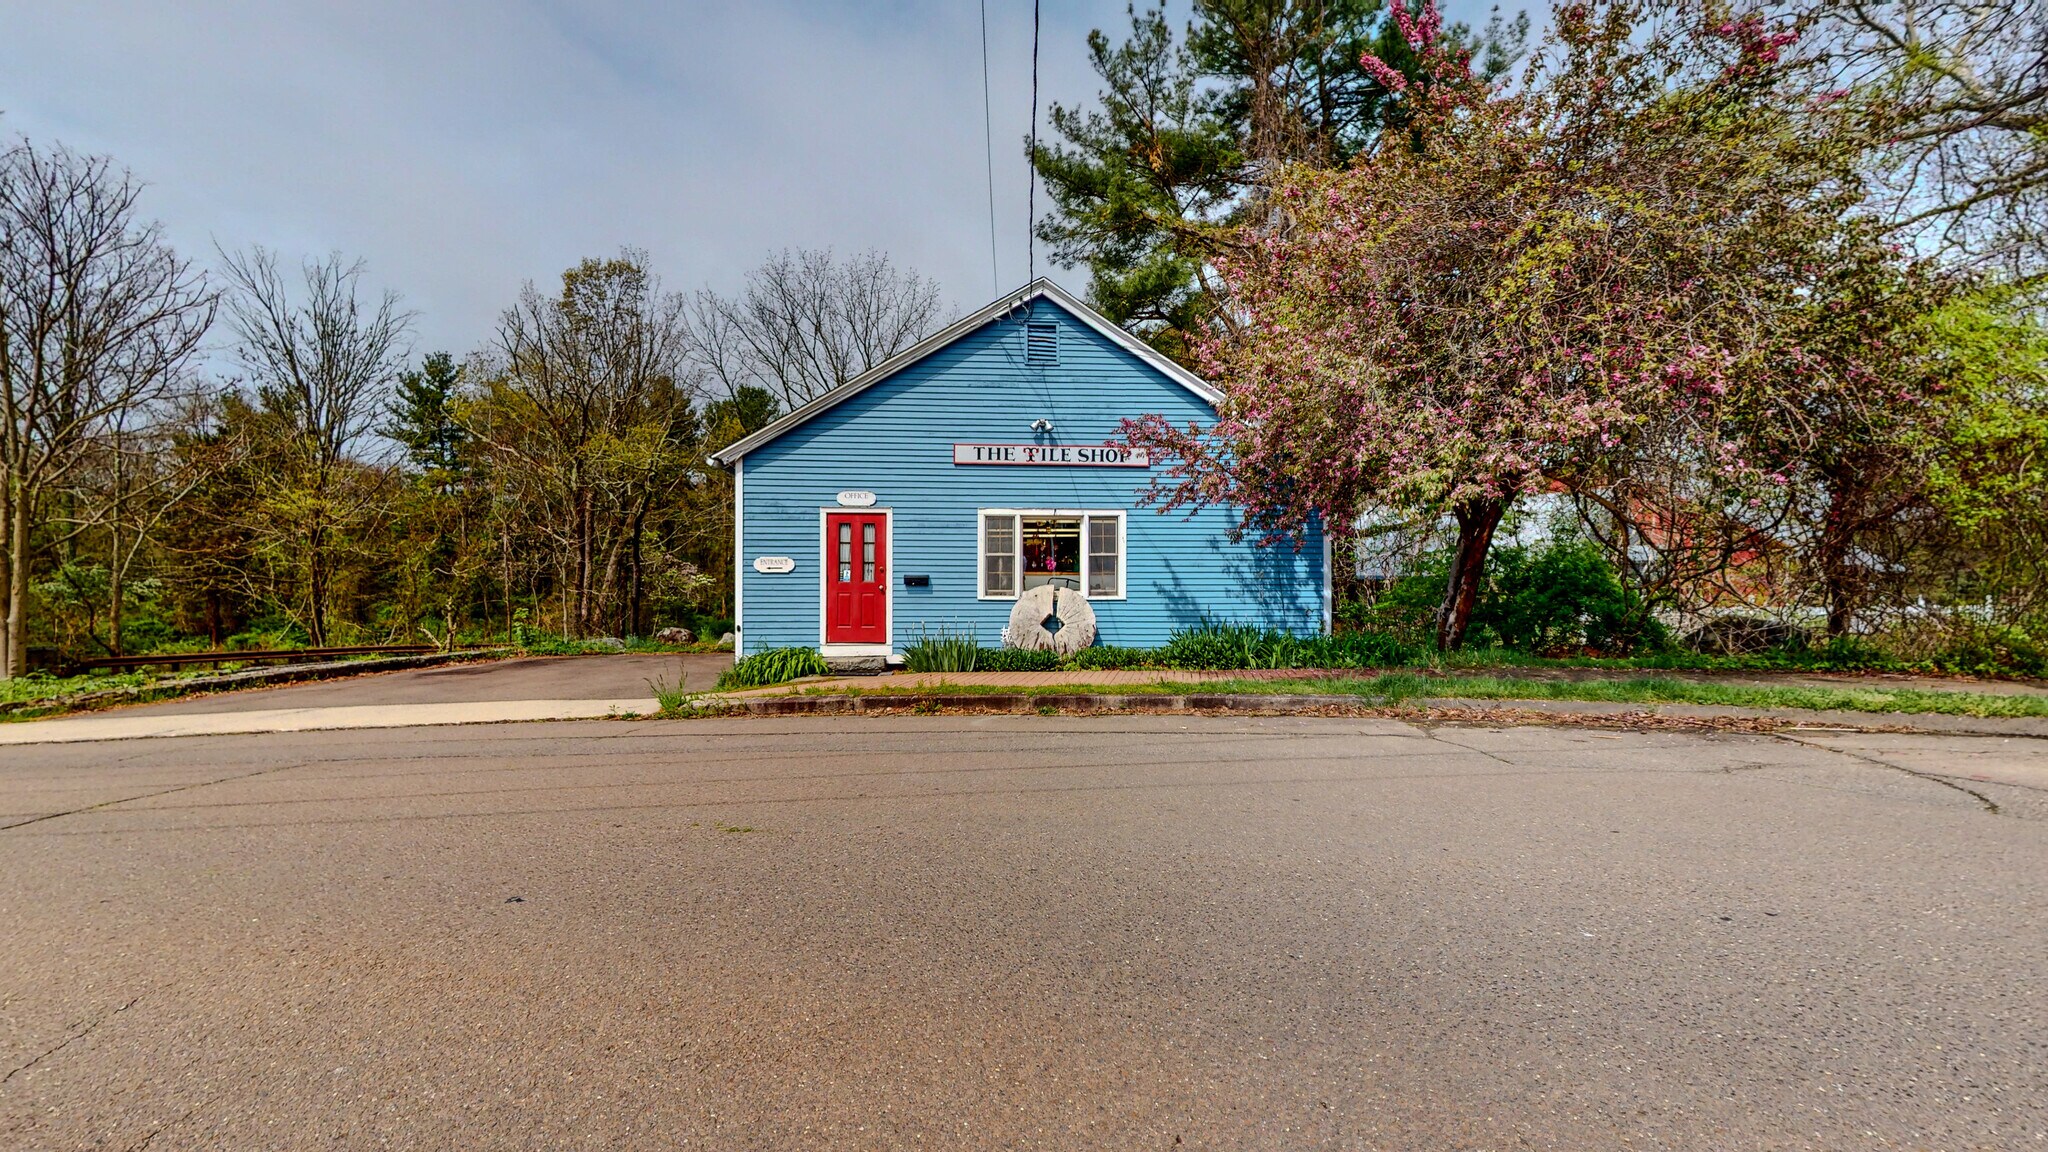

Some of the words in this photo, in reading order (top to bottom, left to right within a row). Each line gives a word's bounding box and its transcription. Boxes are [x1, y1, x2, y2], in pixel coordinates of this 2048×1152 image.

[973, 446, 1015, 462] THE
[1023, 447, 1071, 463] TILE
[760, 558, 788, 566] ENTRANCE
